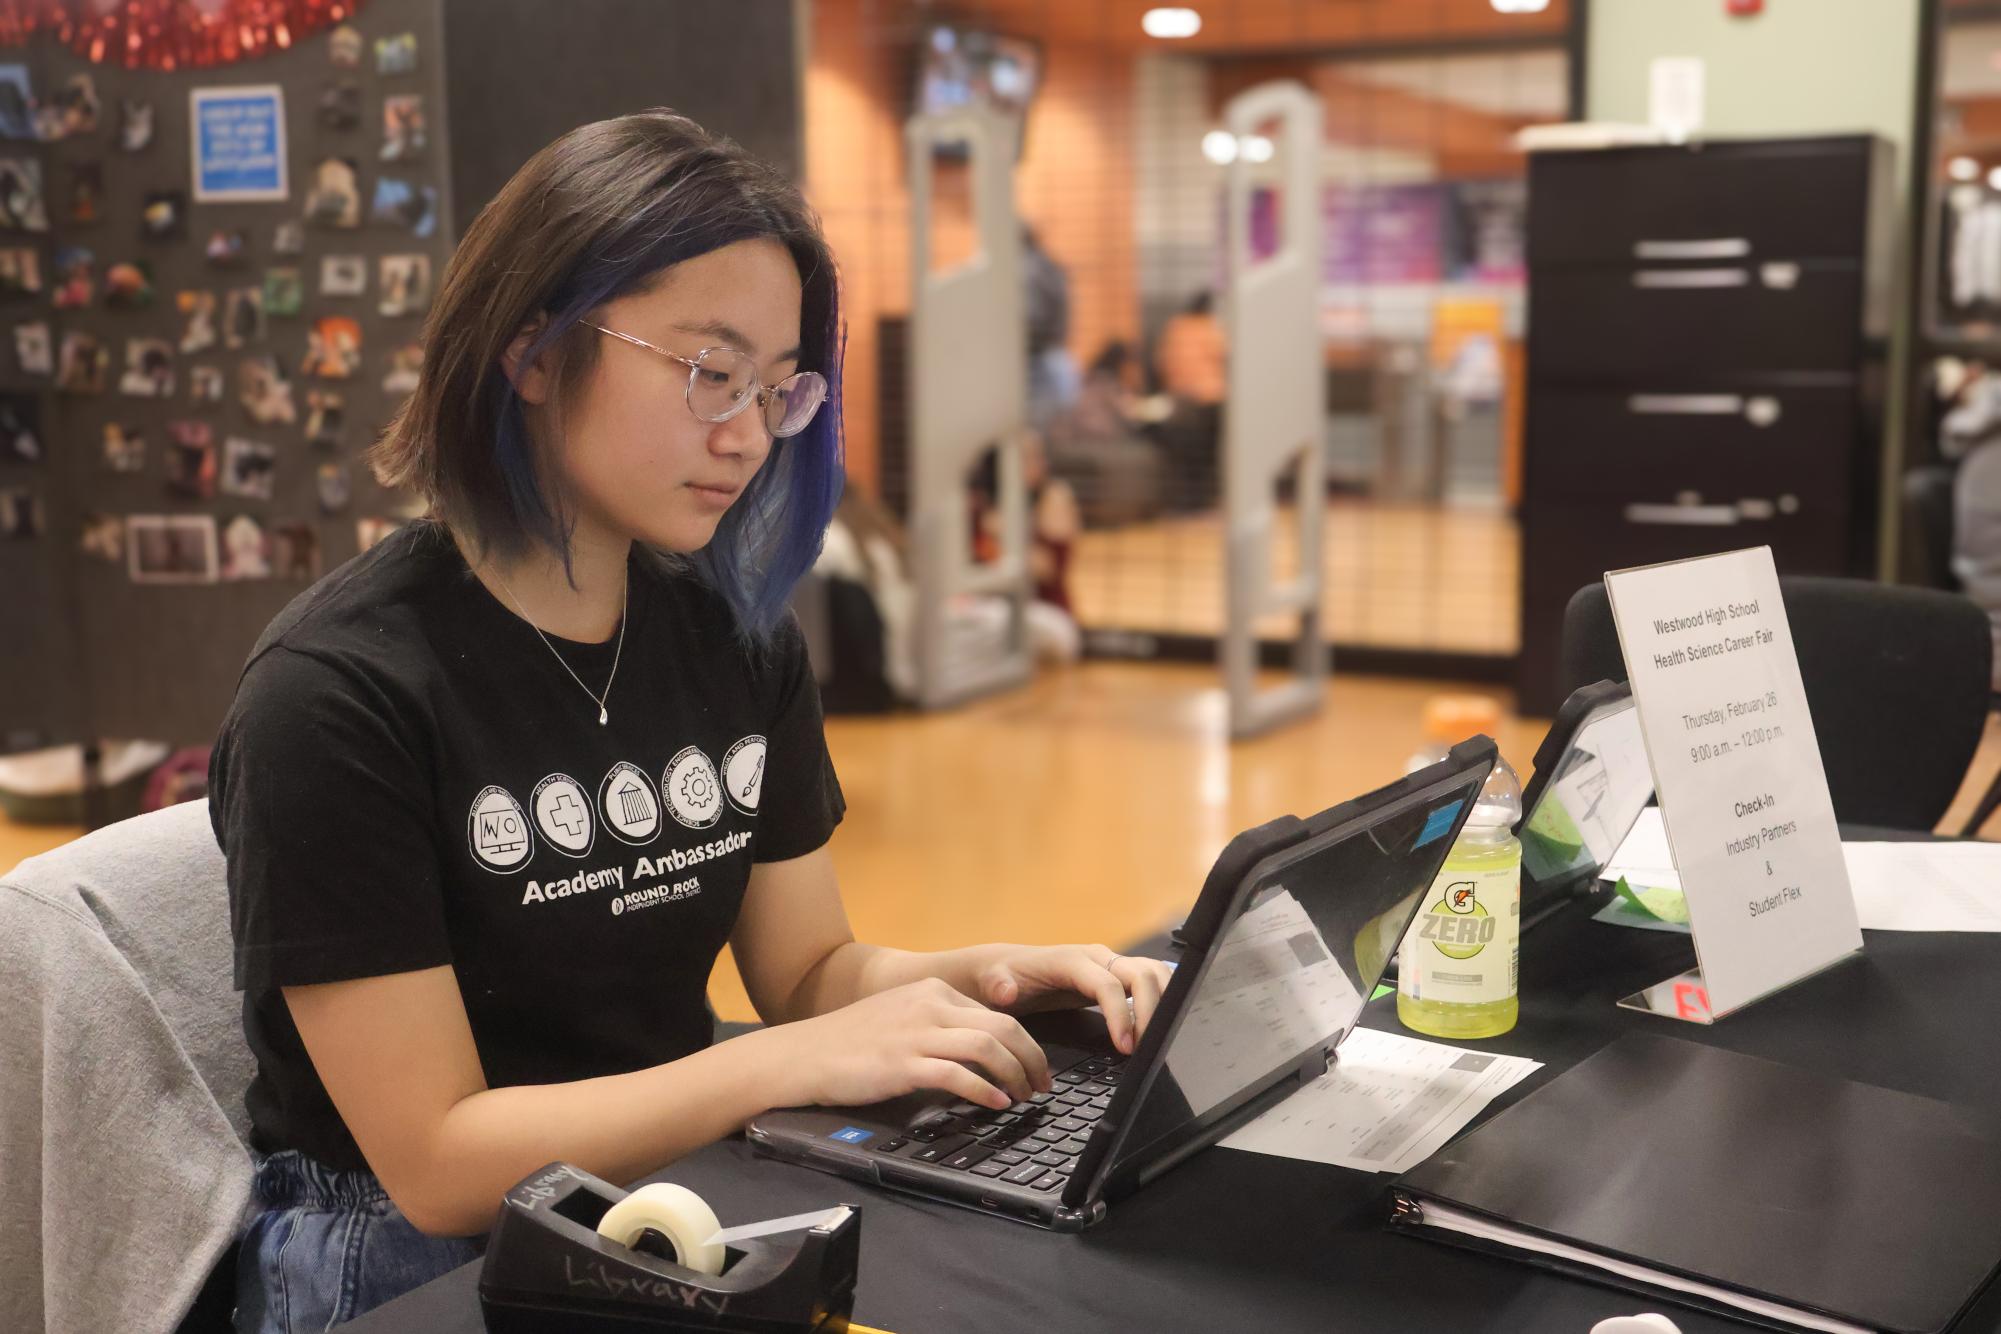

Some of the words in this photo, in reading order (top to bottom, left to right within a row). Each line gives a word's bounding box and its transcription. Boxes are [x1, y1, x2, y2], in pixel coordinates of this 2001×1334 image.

[1653, 610, 1704, 635] Westwood
[1705, 607, 1727, 626] High
[1728, 600, 1760, 619] School
[1653, 649, 1686, 669] Health
[1687, 643, 1724, 661] Science
[1725, 635, 1754, 652] Career
[1755, 629, 1774, 645] Fair
[1682, 709, 1727, 730] Thursday,
[1727, 698, 1765, 718] February
[1765, 691, 1777, 707] 26
[1690, 744, 1712, 763] 9:00
[1713, 742, 1733, 757] a.m.
[1741, 727, 1766, 747] 12:00
[1766, 726, 1784, 741] p.m.
[1734, 793, 1775, 818] Check-In
[1726, 833, 1760, 857] Industry
[1761, 820, 1797, 844] Partners
[522, 866, 625, 904] Academy
[632, 831, 753, 880] Ambassador
[1765, 860, 1773, 876] &
[624, 885, 669, 906] ROUND
[673, 876, 700, 894] ROCK
[1444, 881, 1475, 915] G
[1749, 893, 1783, 917] Student
[1783, 886, 1802, 902] Flex
[1419, 913, 1497, 944] ZERO
[511, 1165, 589, 1210] Library
